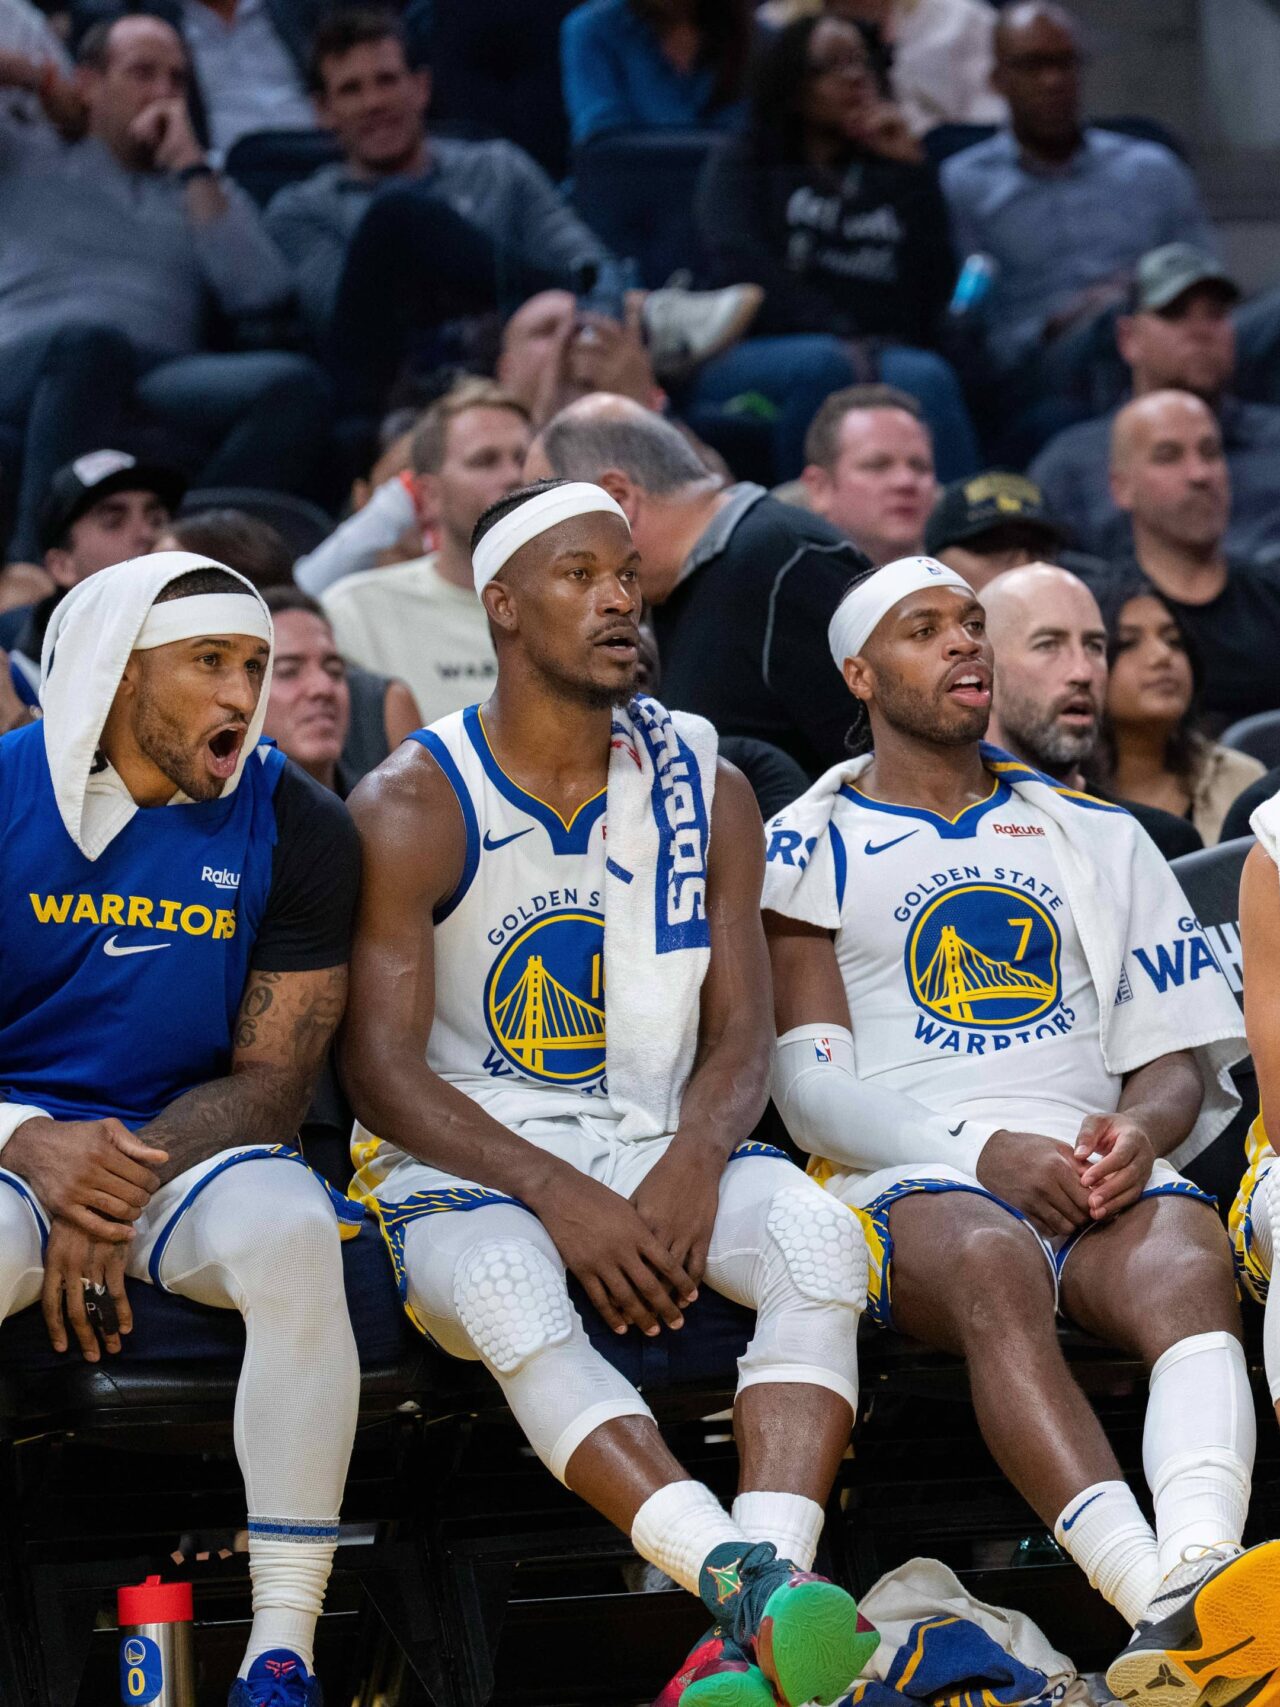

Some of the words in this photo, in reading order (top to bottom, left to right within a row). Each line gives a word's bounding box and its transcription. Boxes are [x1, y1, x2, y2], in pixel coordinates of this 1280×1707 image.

[29, 893, 236, 939] WARRIORS
[487, 888, 578, 946] GOLDEN
[894, 866, 981, 923] GOLDEN
[994, 867, 1064, 911] STATE
[1007, 918, 1033, 961] 7
